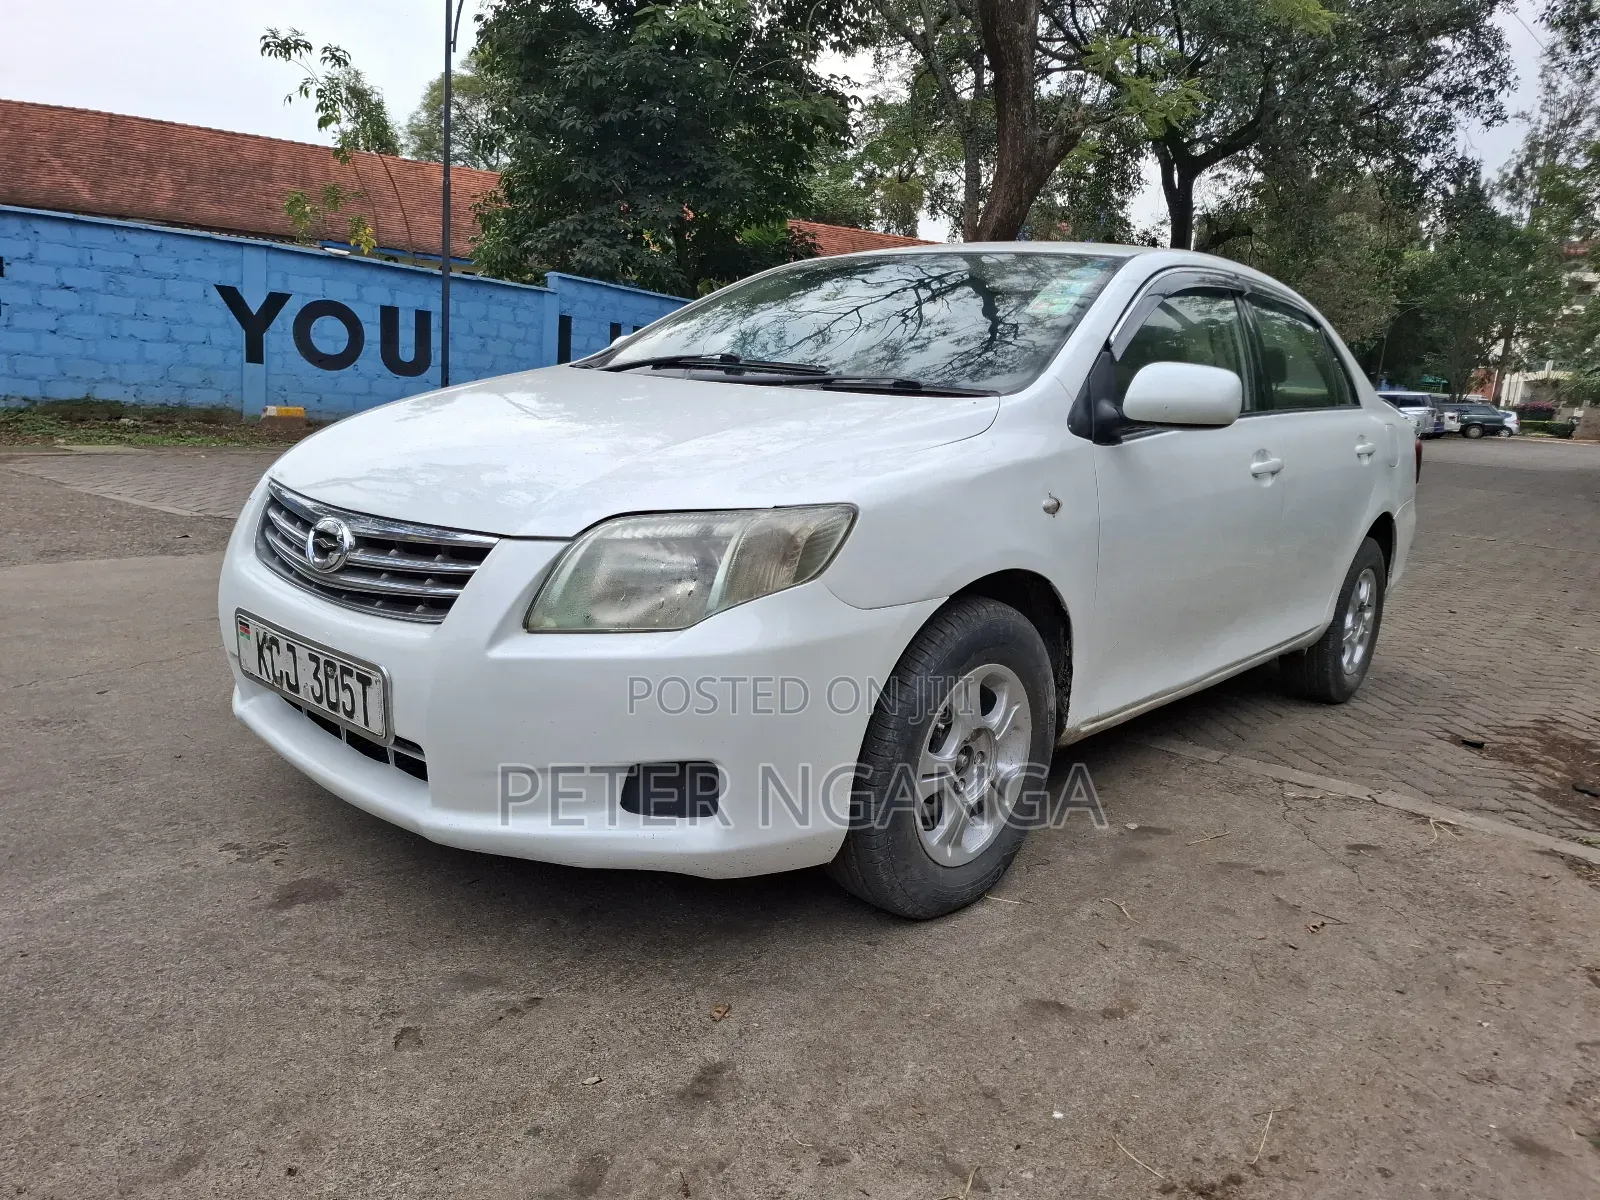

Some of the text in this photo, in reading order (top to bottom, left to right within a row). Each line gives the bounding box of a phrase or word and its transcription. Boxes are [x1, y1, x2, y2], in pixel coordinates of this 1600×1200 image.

[214, 283, 432, 377] YOU
[256, 628, 372, 727] KCJ 305T
